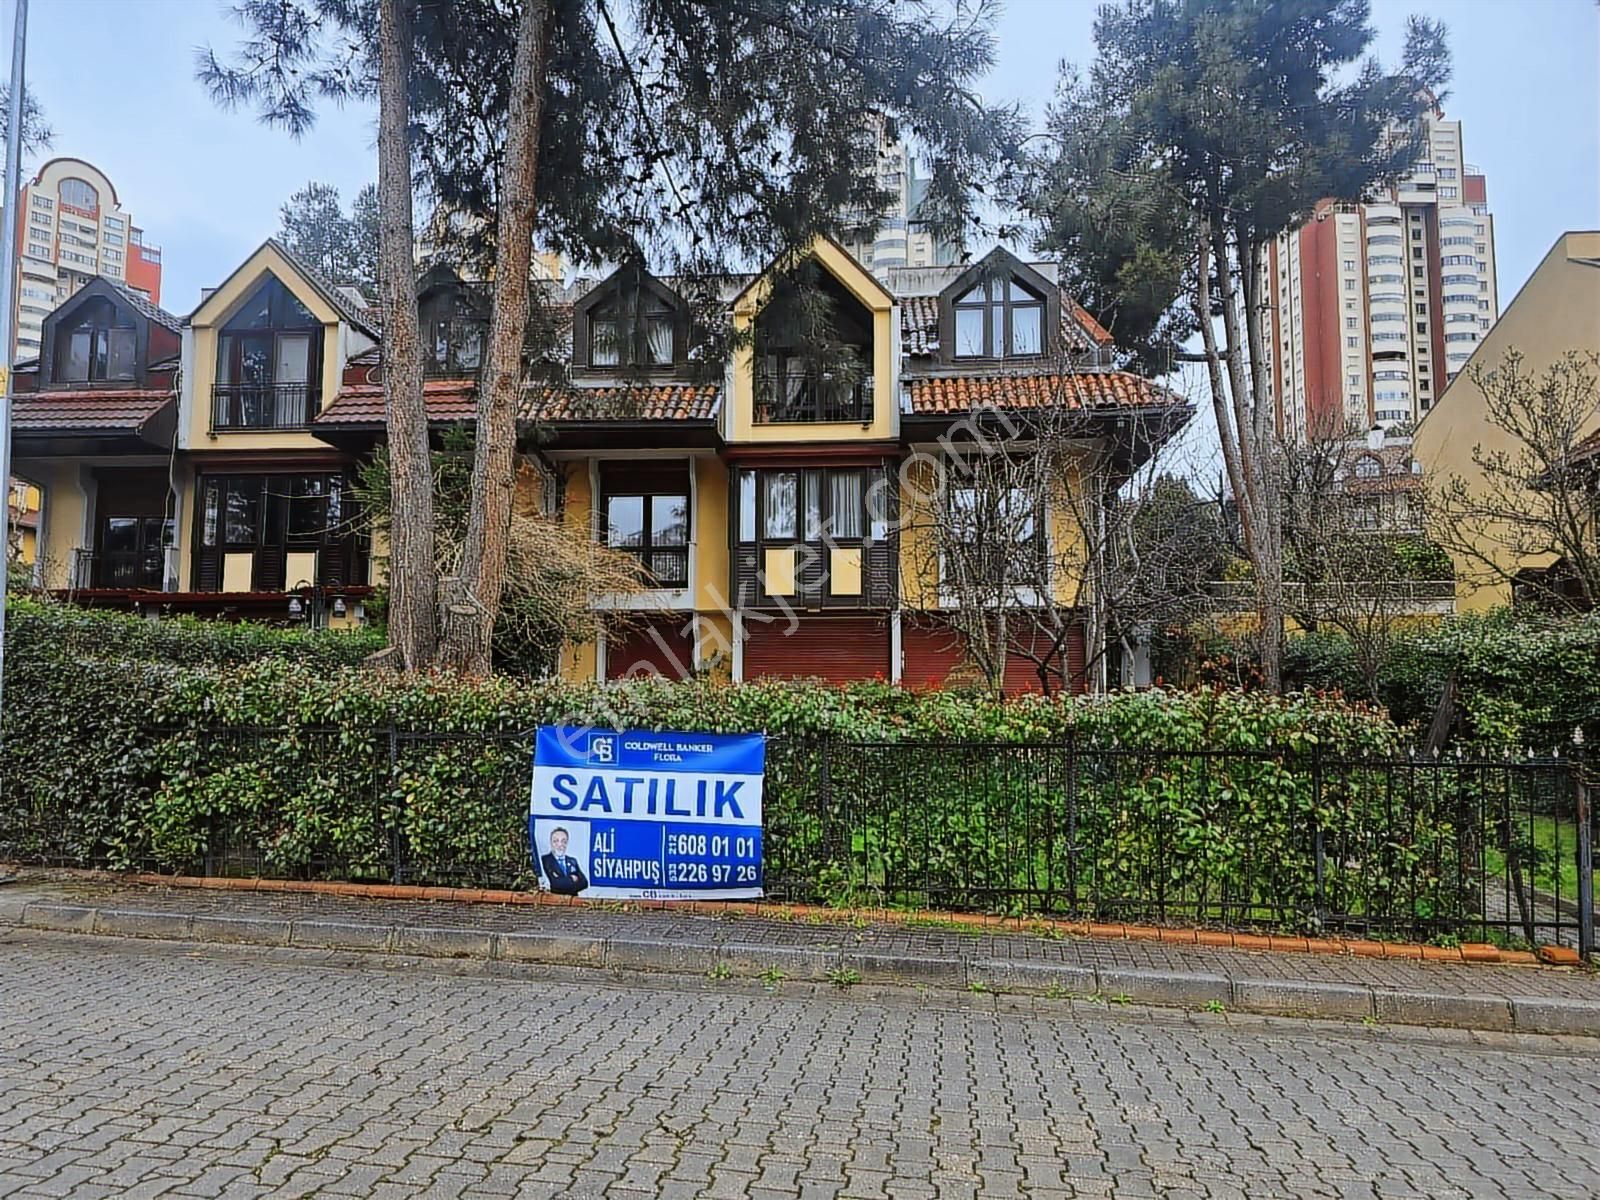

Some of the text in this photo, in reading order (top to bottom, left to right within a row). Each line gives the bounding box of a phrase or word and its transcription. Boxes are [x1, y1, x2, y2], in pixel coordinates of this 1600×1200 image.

[624, 741, 714, 753] COLDWELL BANKER
[654, 753, 682, 762] FLORA
[550, 774, 745, 819] SATILIK
[593, 828, 615, 853] ALİ
[677, 834, 707, 856] 608
[711, 836, 729, 857] 01
[736, 837, 754, 858] 01
[593, 853, 660, 884] SİYAHPUŞ
[678, 863, 708, 882] 226
[712, 864, 731, 883] 97
[737, 865, 757, 882] 26
